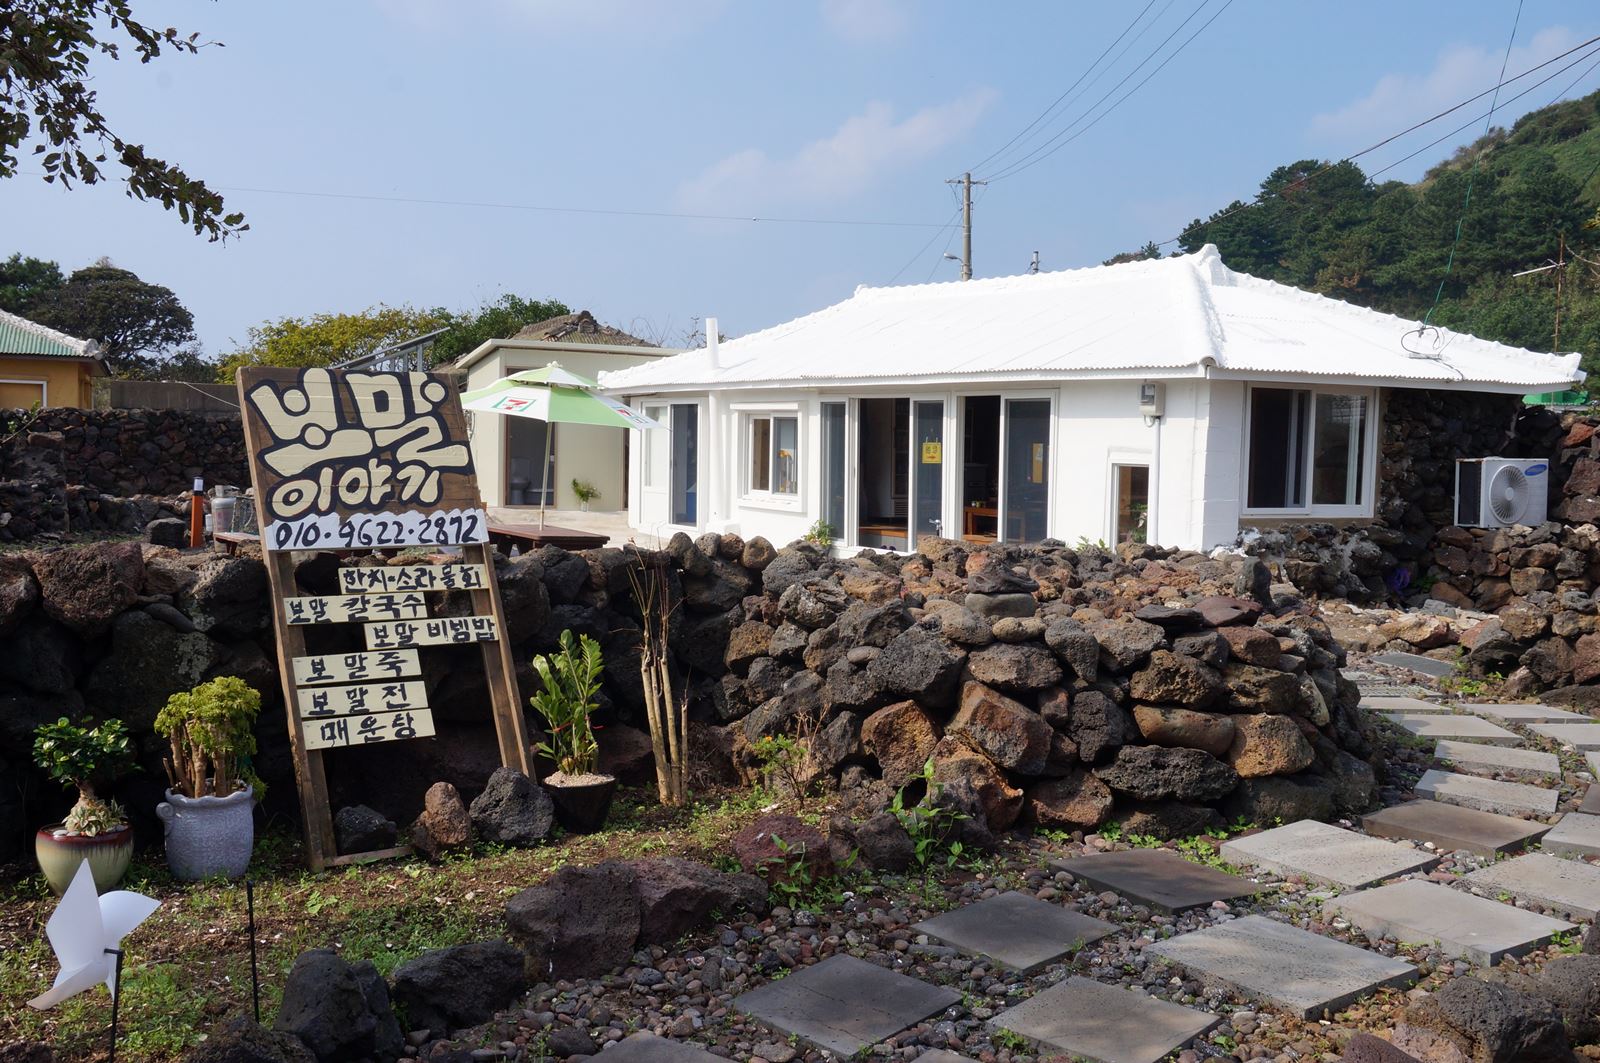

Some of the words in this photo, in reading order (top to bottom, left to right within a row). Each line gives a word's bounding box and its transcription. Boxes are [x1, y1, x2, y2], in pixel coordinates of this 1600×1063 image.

[249, 367, 471, 477] 보말
[271, 458, 441, 518] 이야기
[289, 598, 333, 624] 보말
[340, 594, 425, 621] 칼국수
[373, 622, 420, 648] 보말
[426, 617, 496, 643] 비빔밥
[320, 712, 417, 748] 매운탕
